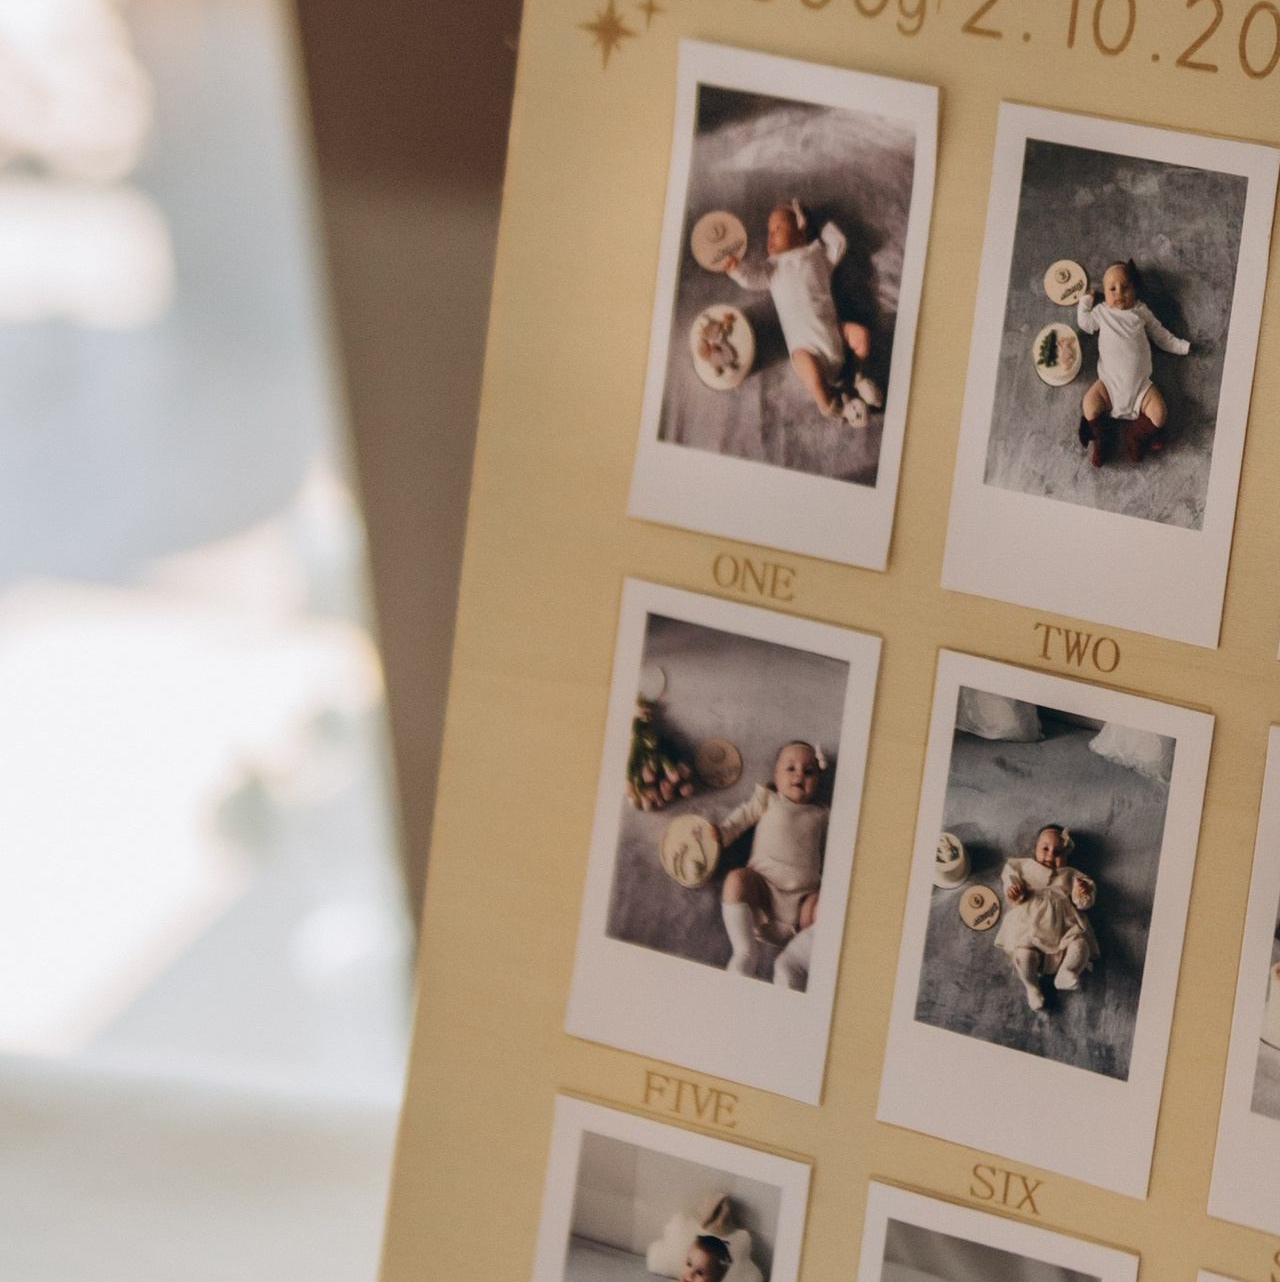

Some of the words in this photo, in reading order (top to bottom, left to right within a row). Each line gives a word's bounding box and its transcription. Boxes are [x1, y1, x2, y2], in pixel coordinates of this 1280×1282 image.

[712, 552, 796, 602] ONE
[1033, 622, 1121, 673] TWO
[641, 1069, 739, 1130] FIVE
[969, 1162, 1044, 1215] SIX
